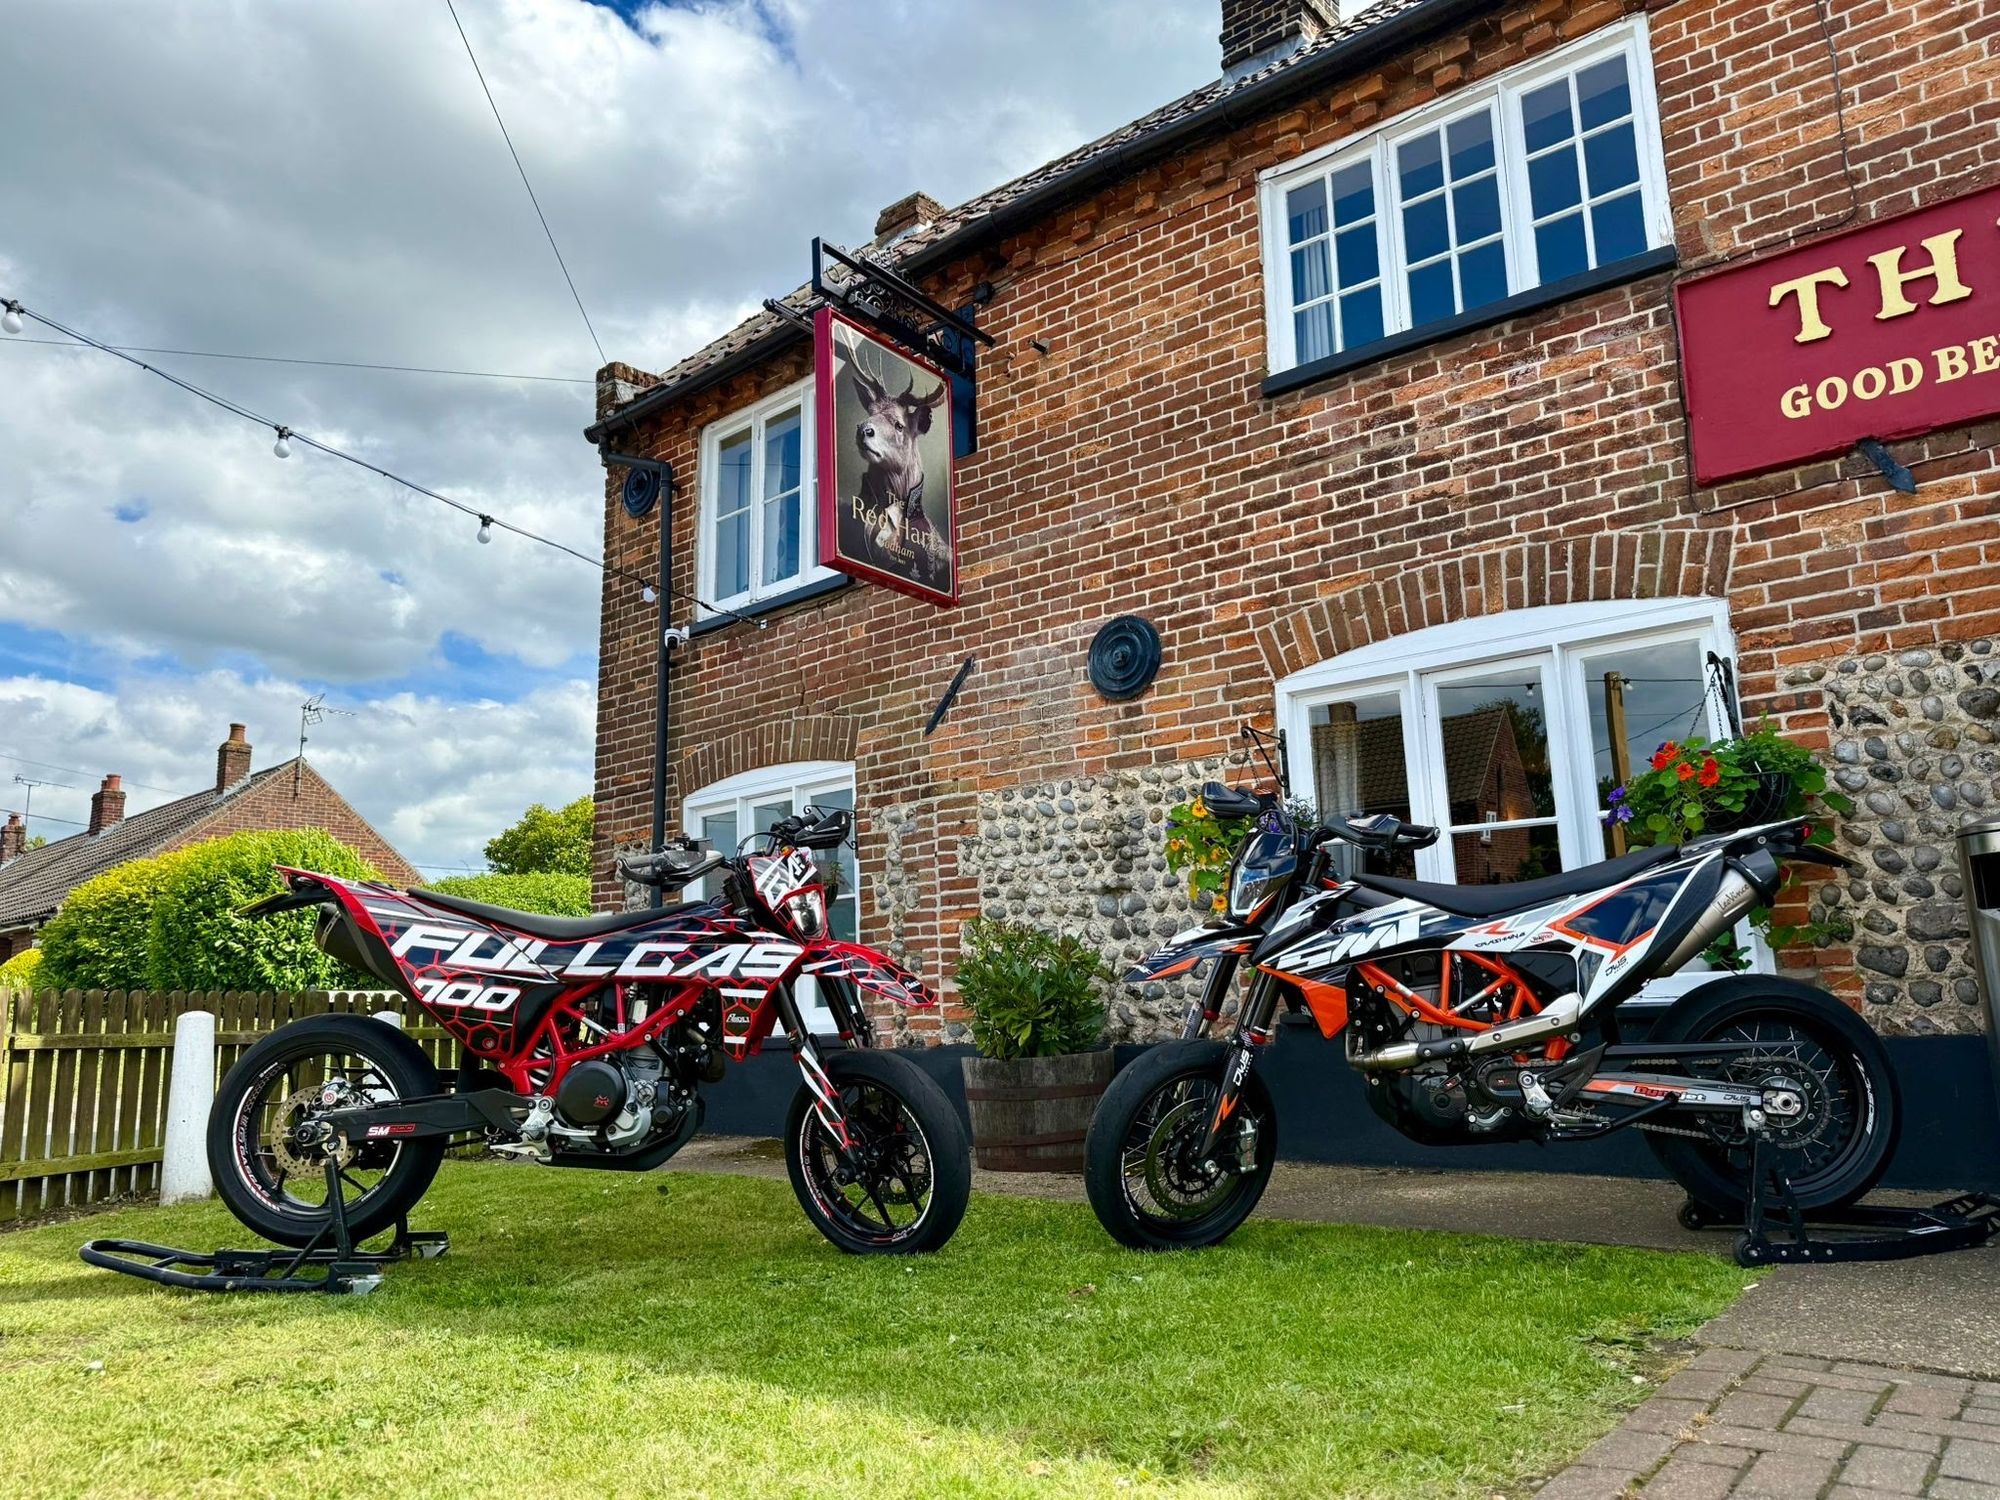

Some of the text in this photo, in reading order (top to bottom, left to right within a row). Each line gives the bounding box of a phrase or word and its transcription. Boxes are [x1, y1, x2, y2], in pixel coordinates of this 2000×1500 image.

[1769, 217, 2000, 343] TH
[1780, 334, 2000, 419] GOOD BE
[852, 495, 889, 530] Red
[886, 490, 906, 510] The
[1233, 1049, 1250, 1087] DWS
